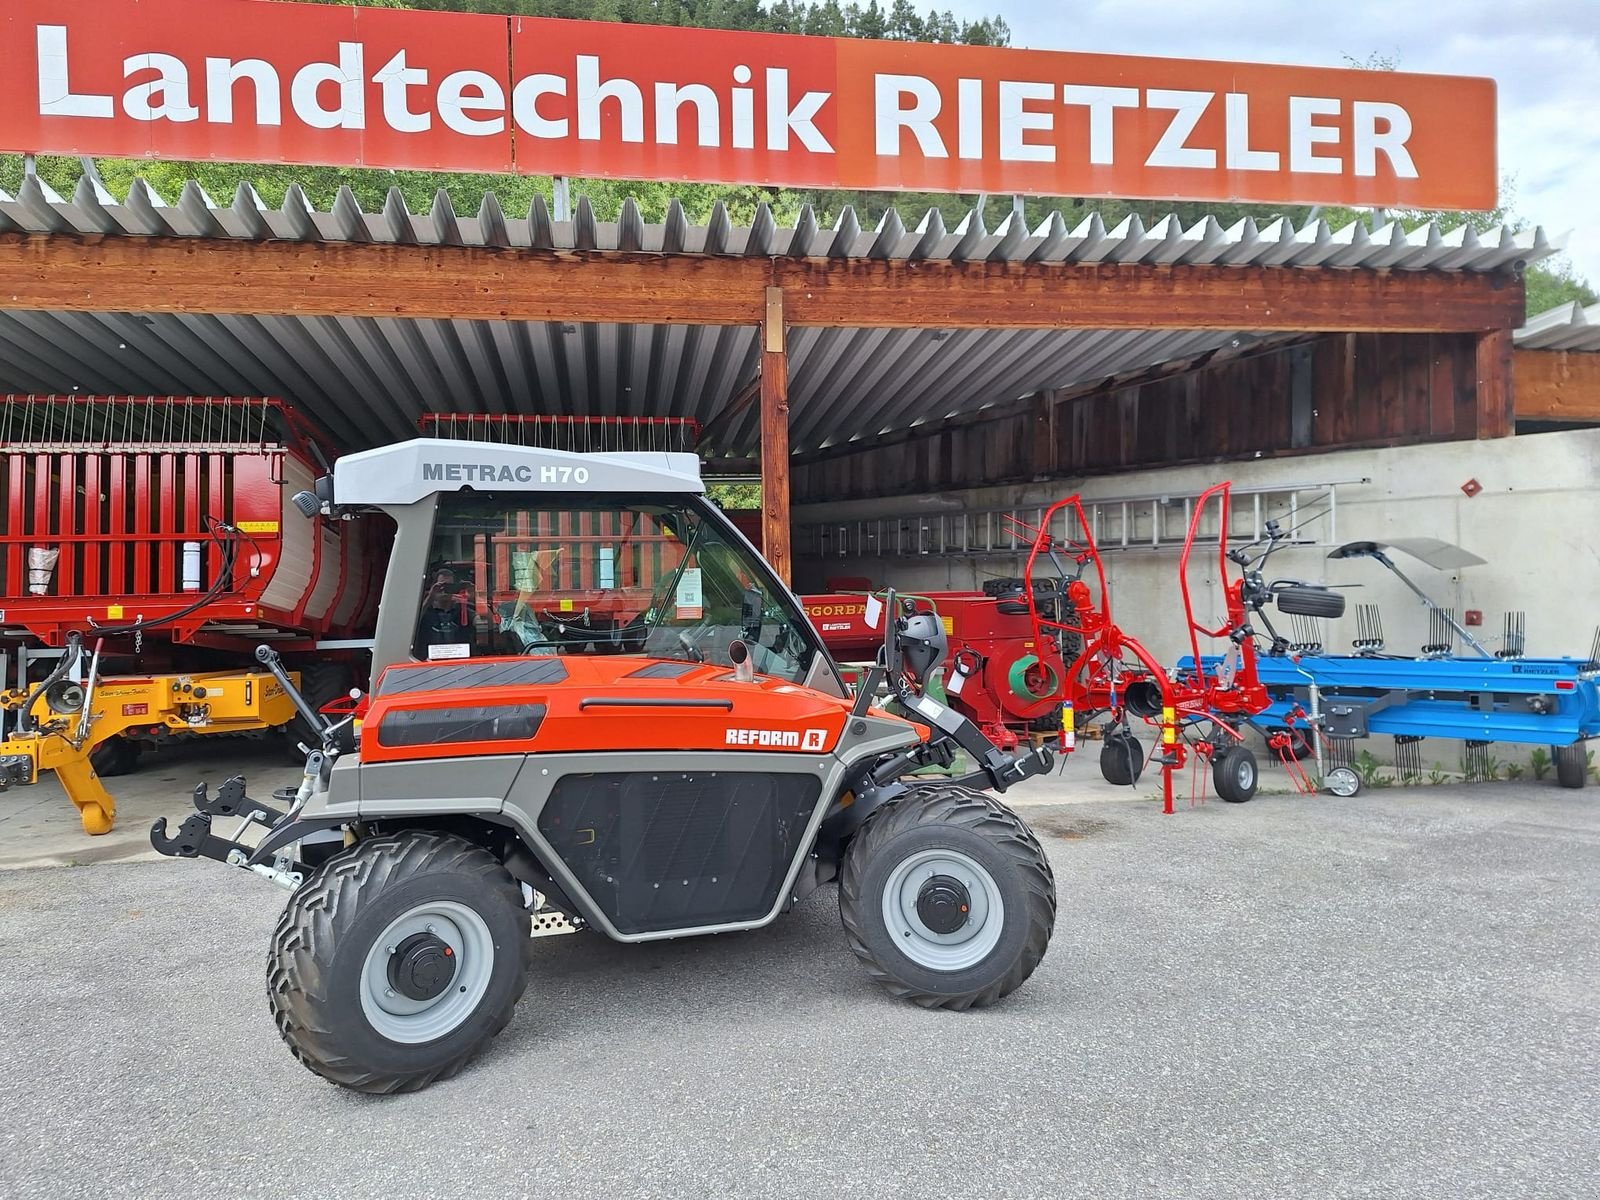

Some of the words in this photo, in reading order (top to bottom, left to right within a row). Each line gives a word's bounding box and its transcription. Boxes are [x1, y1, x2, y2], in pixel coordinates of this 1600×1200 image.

[36, 24, 836, 154] Landtechnik
[874, 72, 1420, 179] RIETZLER
[422, 463, 533, 482] METRAC
[540, 465, 590, 484] H70
[725, 728, 799, 747] REFORM
